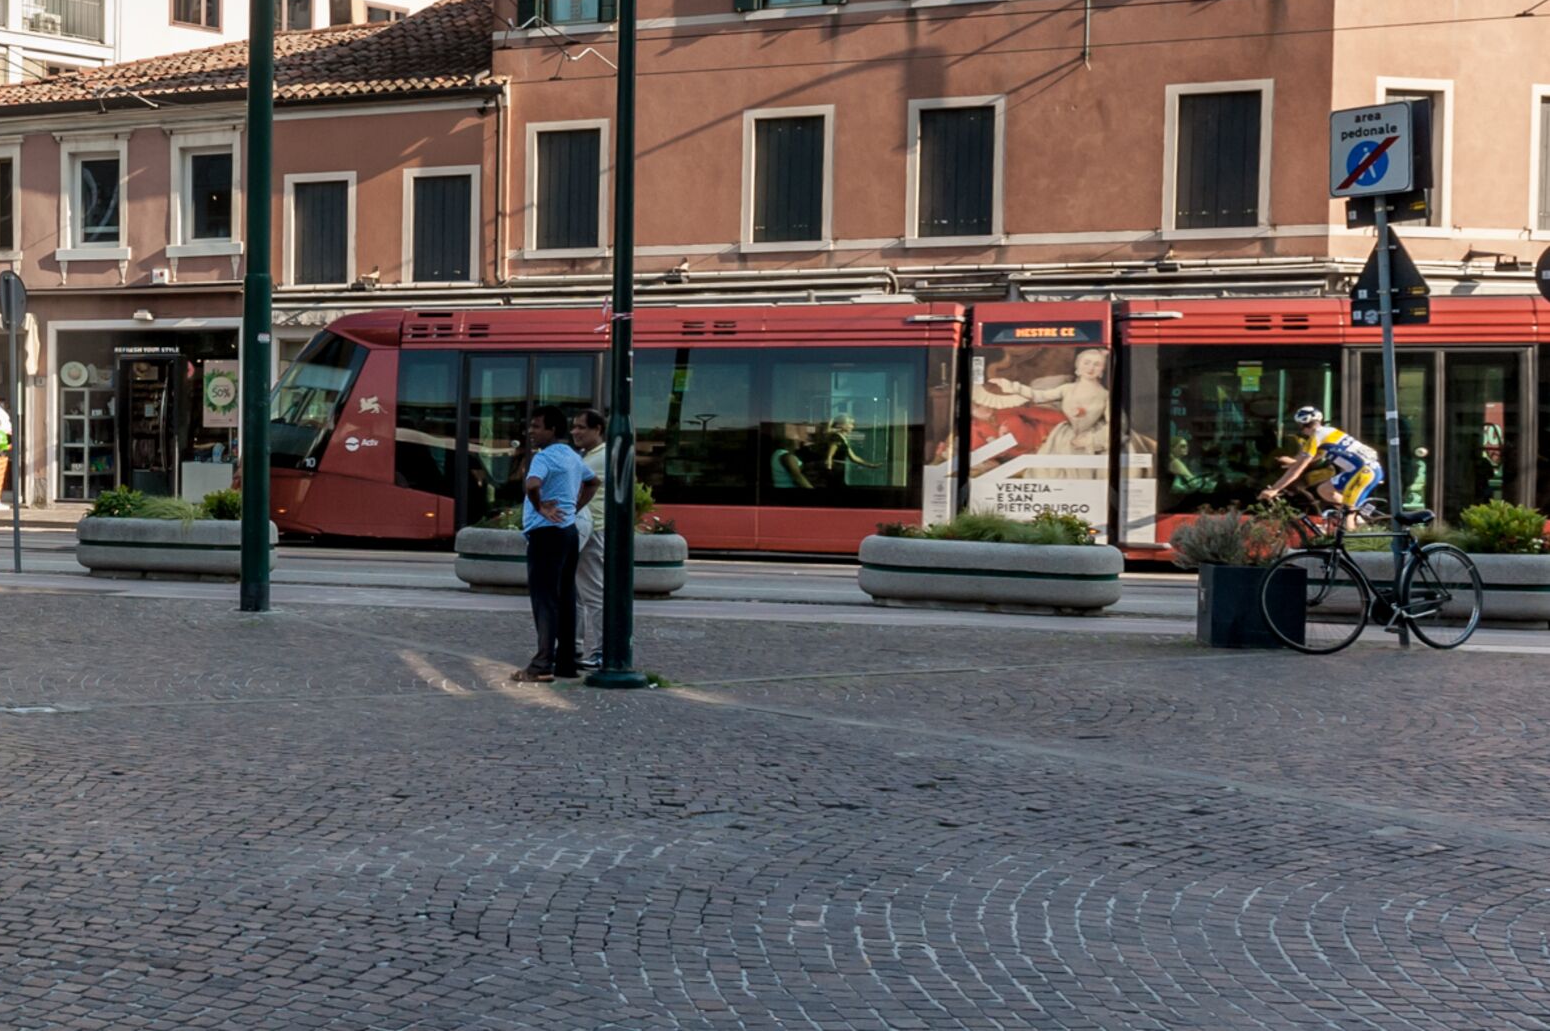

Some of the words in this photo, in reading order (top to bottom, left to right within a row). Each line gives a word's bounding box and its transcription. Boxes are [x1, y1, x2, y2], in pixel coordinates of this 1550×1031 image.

[1354, 112, 1381, 123] area
[1341, 123, 1398, 142] pedonale
[1014, 328, 1058, 338] MESTRE
[161, 346, 180, 354] STYLE
[212, 388, 231, 399] 50%
[305, 457, 316, 468] 10
[996, 483, 1051, 493] VENEZIA
[997, 493, 1004, 502] E
[1008, 493, 1033, 503] SAN
[997, 503, 1090, 514] PIETROBURGO
